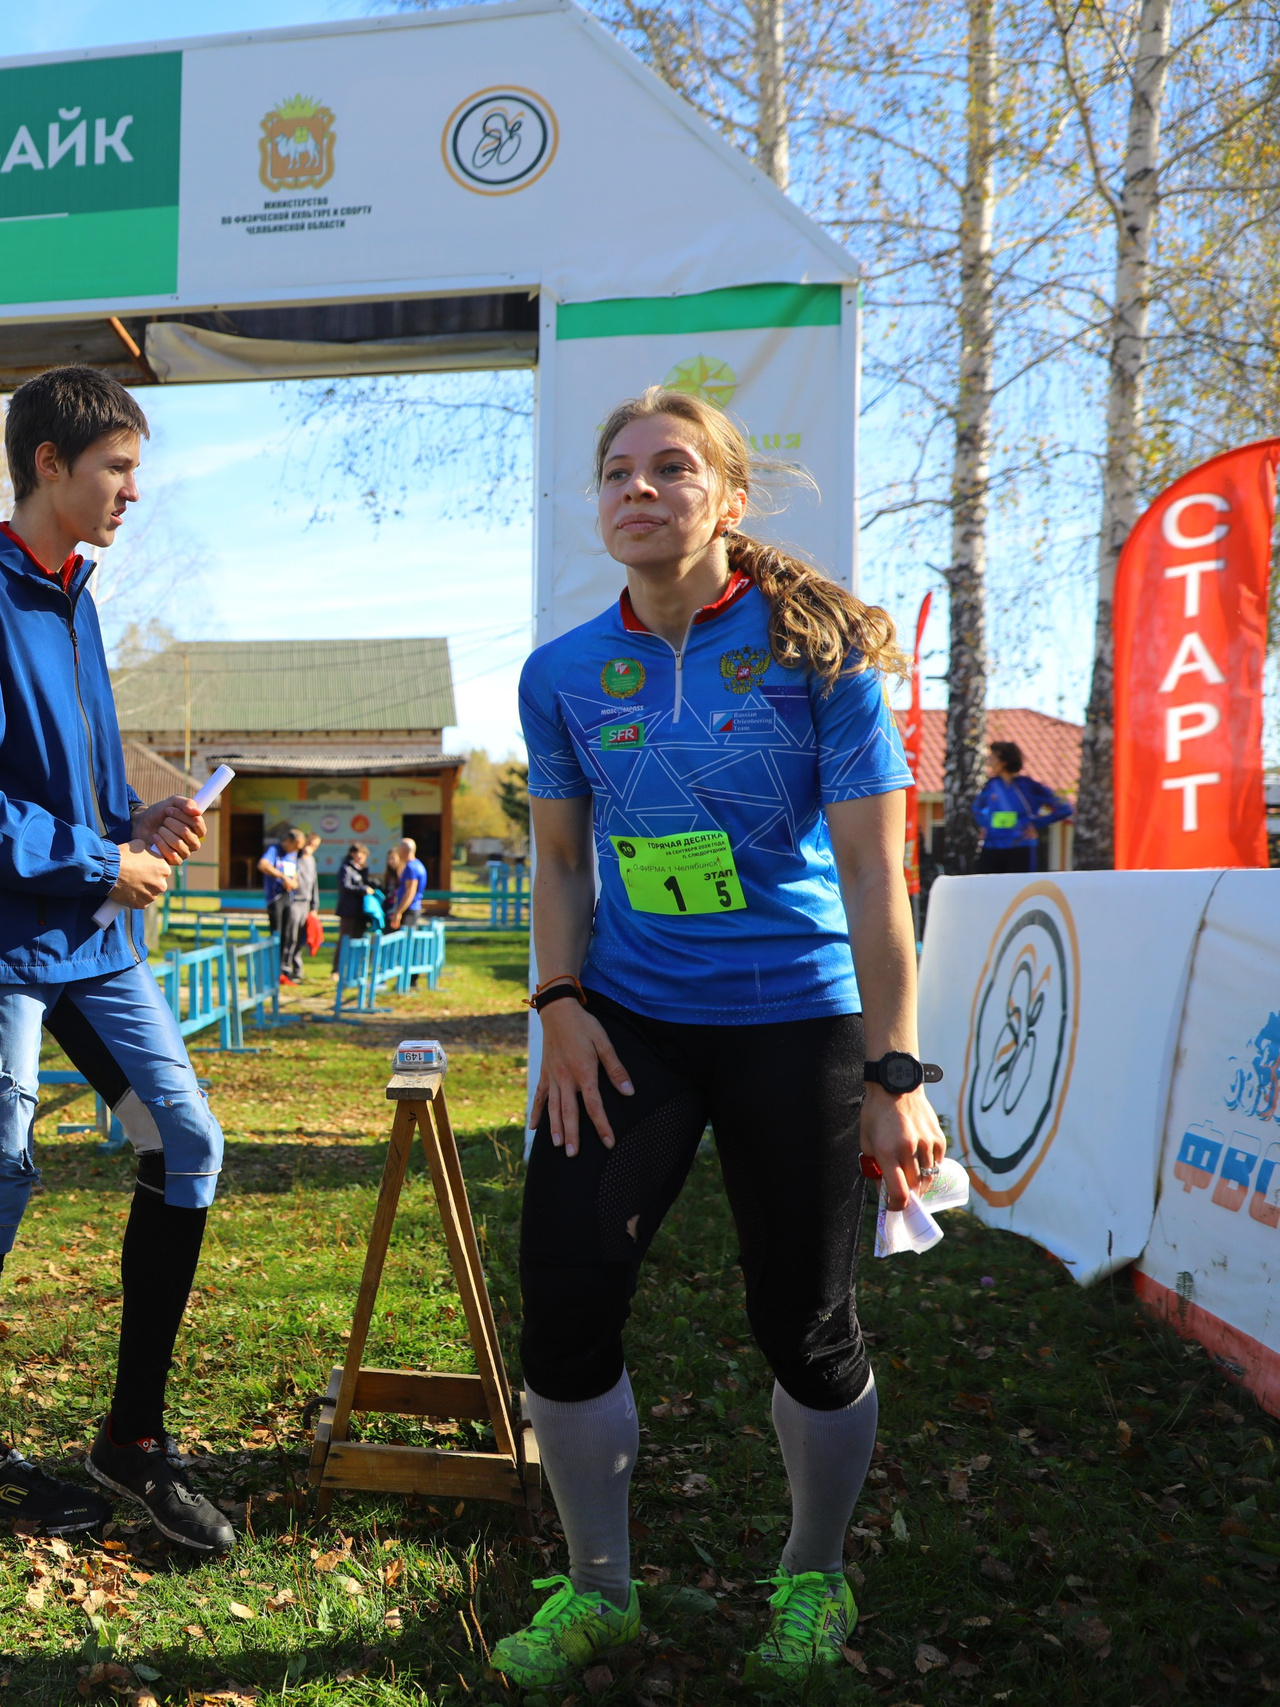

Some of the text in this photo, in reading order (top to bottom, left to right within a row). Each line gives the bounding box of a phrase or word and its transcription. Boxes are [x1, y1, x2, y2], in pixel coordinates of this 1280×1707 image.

[264, 197, 328, 210] МИНИСТЕРСТВО
[221, 216, 232, 225] ПО
[234, 210, 289, 224] ФИЗИЧЕСКОЙ
[291, 207, 331, 220] КУЛЬТУРЕ
[340, 205, 372, 216] СПОРТУ
[246, 219, 345, 235] ЧЕЛЯБИНСКОЙ ОБЛАСТИ
[1158, 492, 1231, 832] СТАРТ
[733, 717, 773, 725] Orienteering
[608, 728, 635, 743] SFR
[647, 833, 723, 850] ГОРЯЧАЯ ДЕСЯТКА
[622, 845, 632, 853] 10
[688, 847, 727, 859] СЛЮДОРУДНИК
[674, 861, 718, 872] Челябинск
[703, 869, 733, 881] ЭТАП
[664, 875, 687, 912] 1
[715, 880, 732, 908] 5
[405, 1052, 423, 1061] 149
